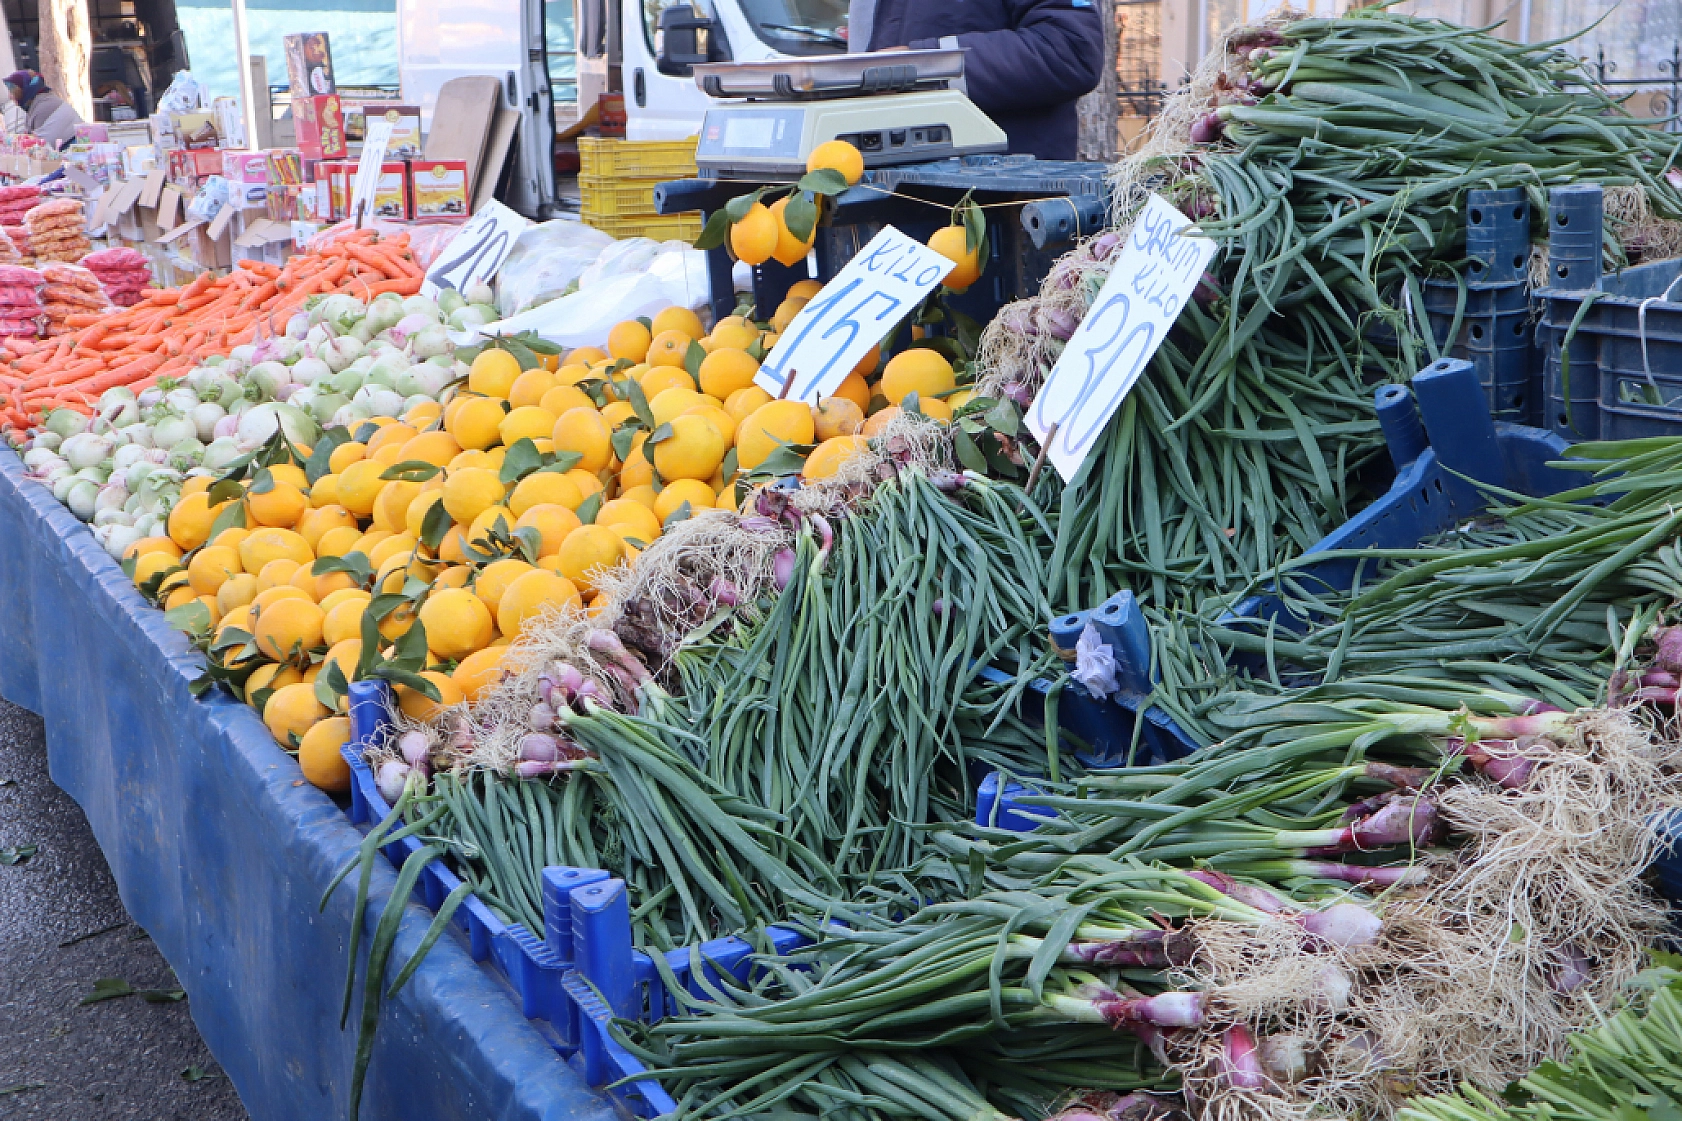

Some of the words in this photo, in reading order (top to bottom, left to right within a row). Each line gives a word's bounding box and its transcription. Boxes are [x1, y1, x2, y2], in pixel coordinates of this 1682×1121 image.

[427, 217, 509, 297] 20
[760, 277, 902, 400] 15
[1037, 293, 1155, 456] 30
